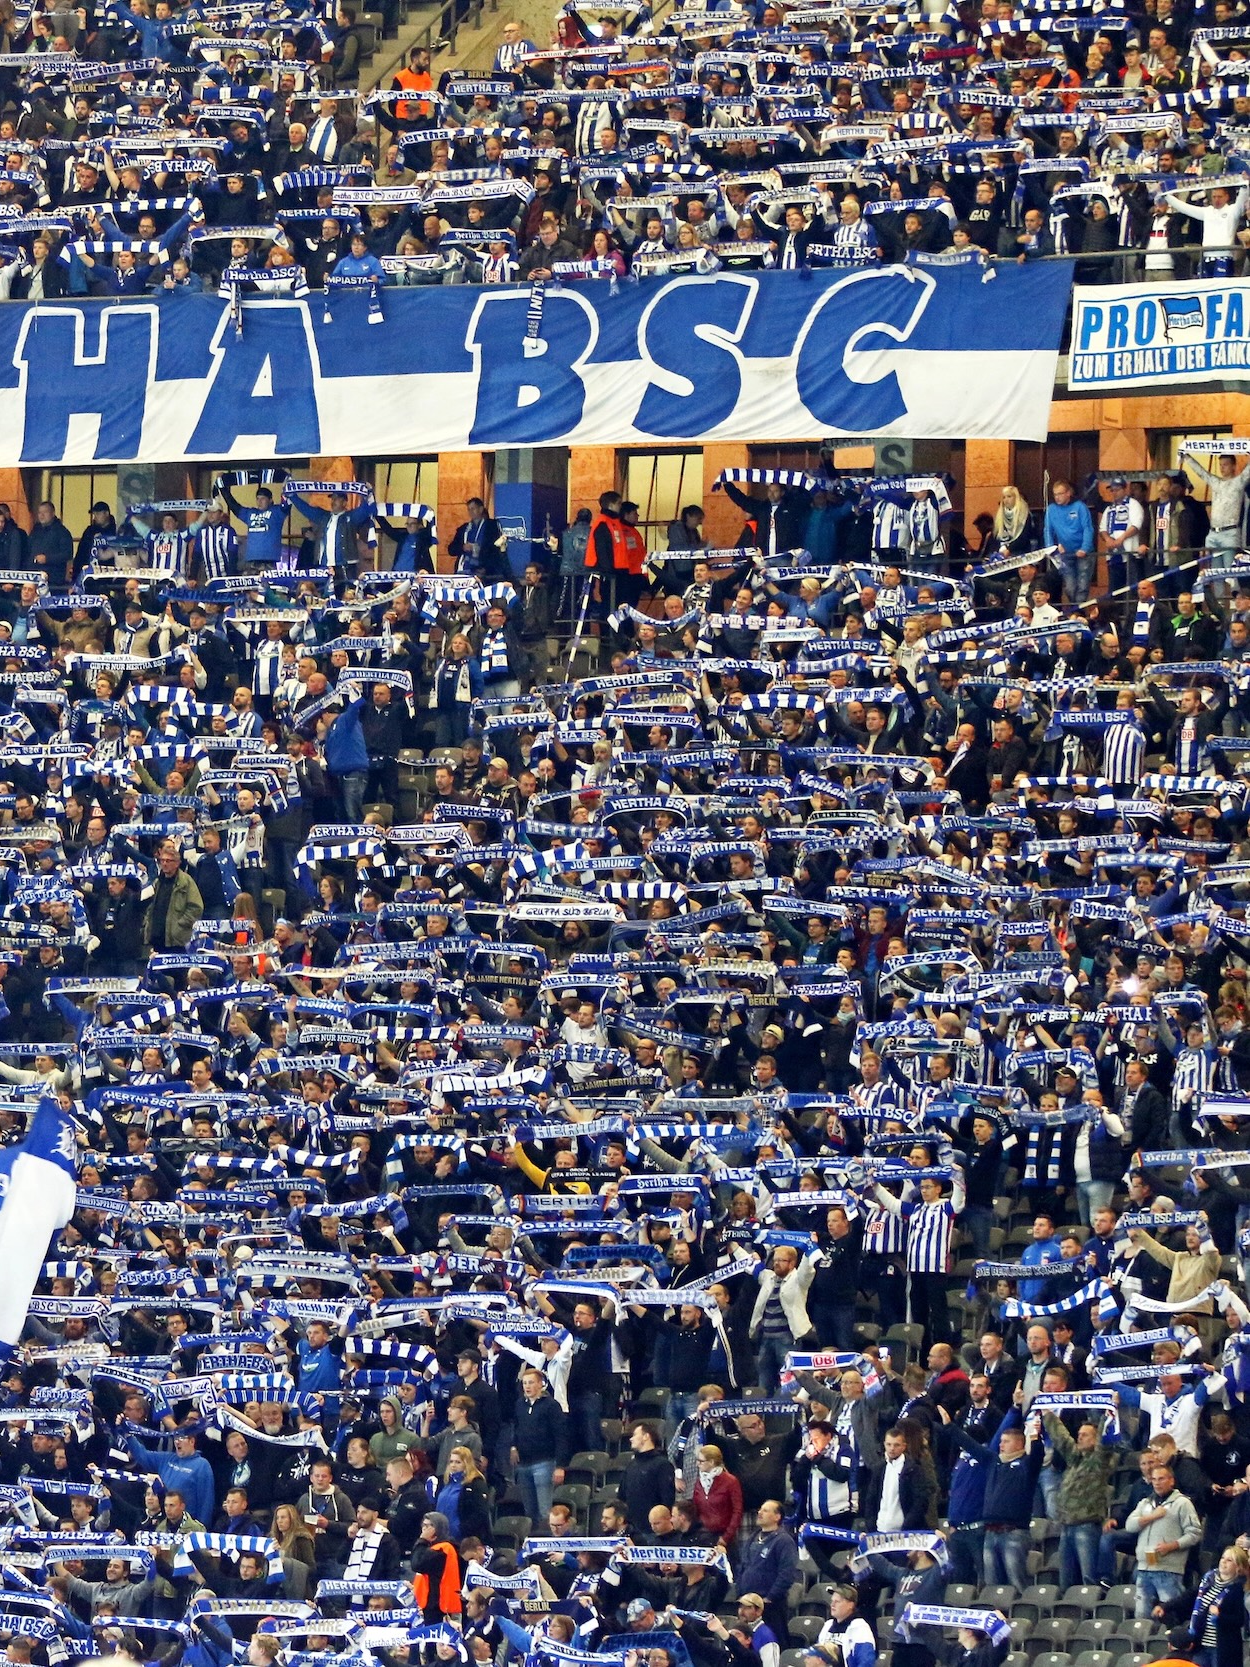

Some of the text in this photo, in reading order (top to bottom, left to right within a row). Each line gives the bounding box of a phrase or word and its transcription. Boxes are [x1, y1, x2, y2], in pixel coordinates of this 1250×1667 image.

[453, 83, 491, 93] HERTHA
[634, 86, 701, 98] HERTHA BSC
[11, 172, 35, 182] BSC
[229, 267, 296, 281] Hertha BSC
[1080, 292, 1250, 350] PRO FA
[1168, 313, 1202, 327] Hertha BSC
[464, 263, 938, 446] BSC
[1074, 354, 1109, 380] ZUM
[1113, 347, 1171, 377] ERHALT
[1176, 345, 1206, 371] DER
[1184, 441, 1248, 451] HERTHA BSC
[286, 482, 337, 492] Hertha
[596, 672, 673, 688] HERTHA BSC
[1060, 711, 1129, 723] HERTHA BSC
[1181, 729, 1195, 740] DB
[611, 798, 690, 811] HERTHA BSC
[570, 856, 636, 869] JOE SIMUNIC
[968, 909, 991, 919] BSC
[60, 979, 127, 990] 125 JAHRE
[1049, 1011, 1069, 1023] BEER
[1082, 1011, 1107, 1024] HATE
[279, 1181, 312, 1192] Union
[637, 1177, 671, 1189] Hertha
[180, 1192, 269, 1205] HEIMSIEG
[777, 1190, 843, 1202] BERLIN
[1153, 1213, 1174, 1224] BSC
[868, 1221, 884, 1234] DB
[1104, 1327, 1169, 1350] LUSTENBERGER
[813, 1354, 836, 1368] DB
[1121, 1367, 1172, 1380] Hertha BSC
[746, 1403, 801, 1416] HERTHA
[631, 1547, 706, 1560] Hertha BSC
[326, 1581, 397, 1592] HERTHA BSC
[365, 1637, 407, 1648] Hertha BSC
